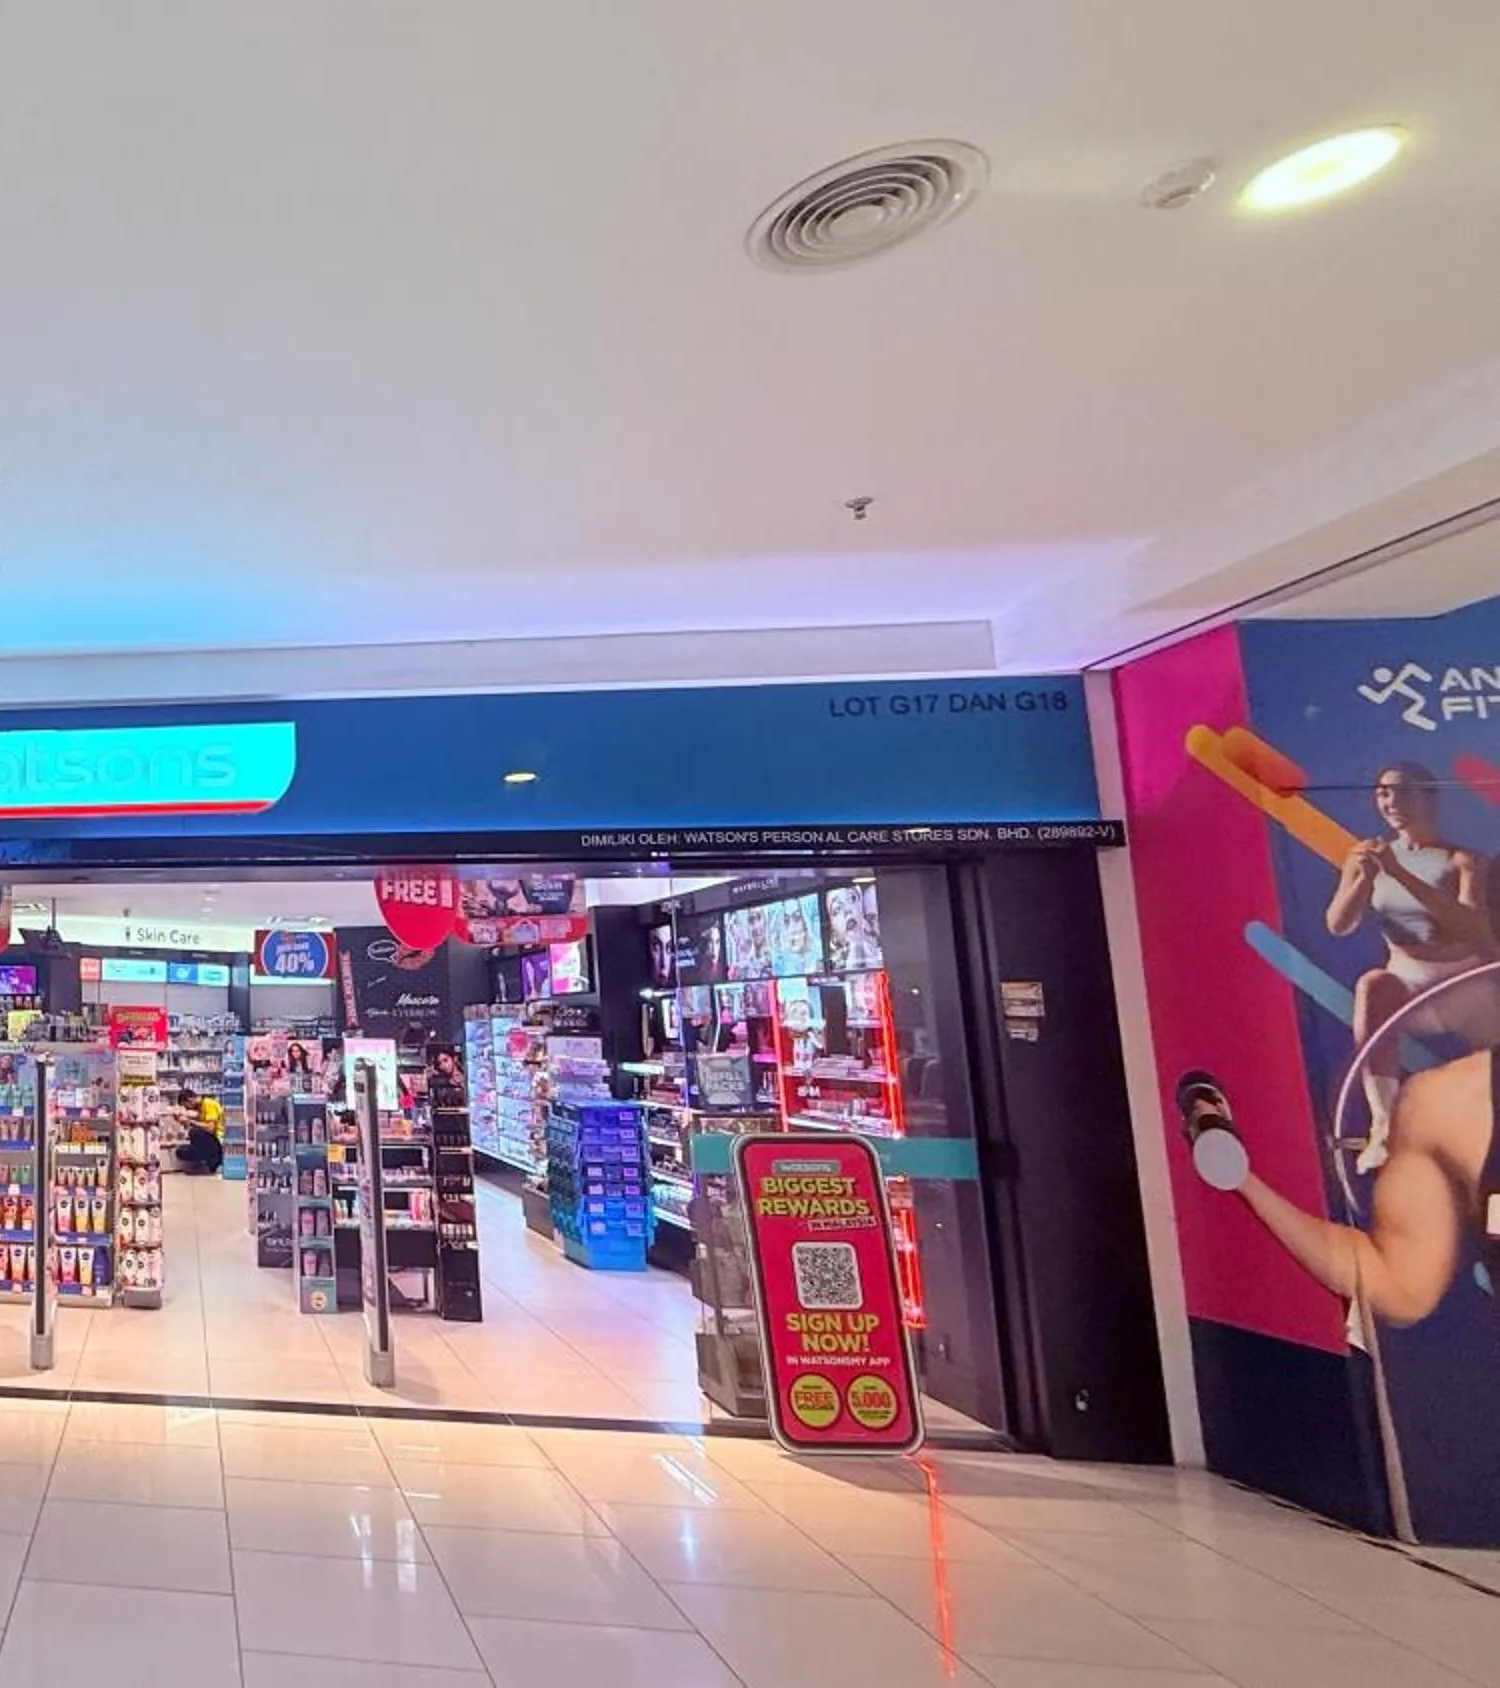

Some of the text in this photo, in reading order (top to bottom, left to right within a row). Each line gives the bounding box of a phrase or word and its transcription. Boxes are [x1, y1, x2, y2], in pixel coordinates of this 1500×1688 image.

[829, 690, 1068, 717] LOT G17 DAN G18
[581, 834, 635, 846] DIMILIKI
[683, 831, 759, 843] WATSON'S
[762, 831, 844, 843] PERSONAL
[847, 831, 890, 843] CARE
[893, 829, 952, 842] STORES
[957, 828, 991, 841] SDN.
[997, 827, 1033, 840] BHD.
[381, 875, 437, 905] FREE
[137, 928, 201, 944] Skin Care
[275, 953, 315, 973] 40%
[763, 1177, 856, 1196] BIGGEST
[759, 1197, 870, 1217] REWARDS
[786, 1313, 880, 1333] SIGN UP
[802, 1333, 870, 1352] NOW!
[869, 1356, 891, 1366] APP
[794, 1391, 834, 1407] FREE
